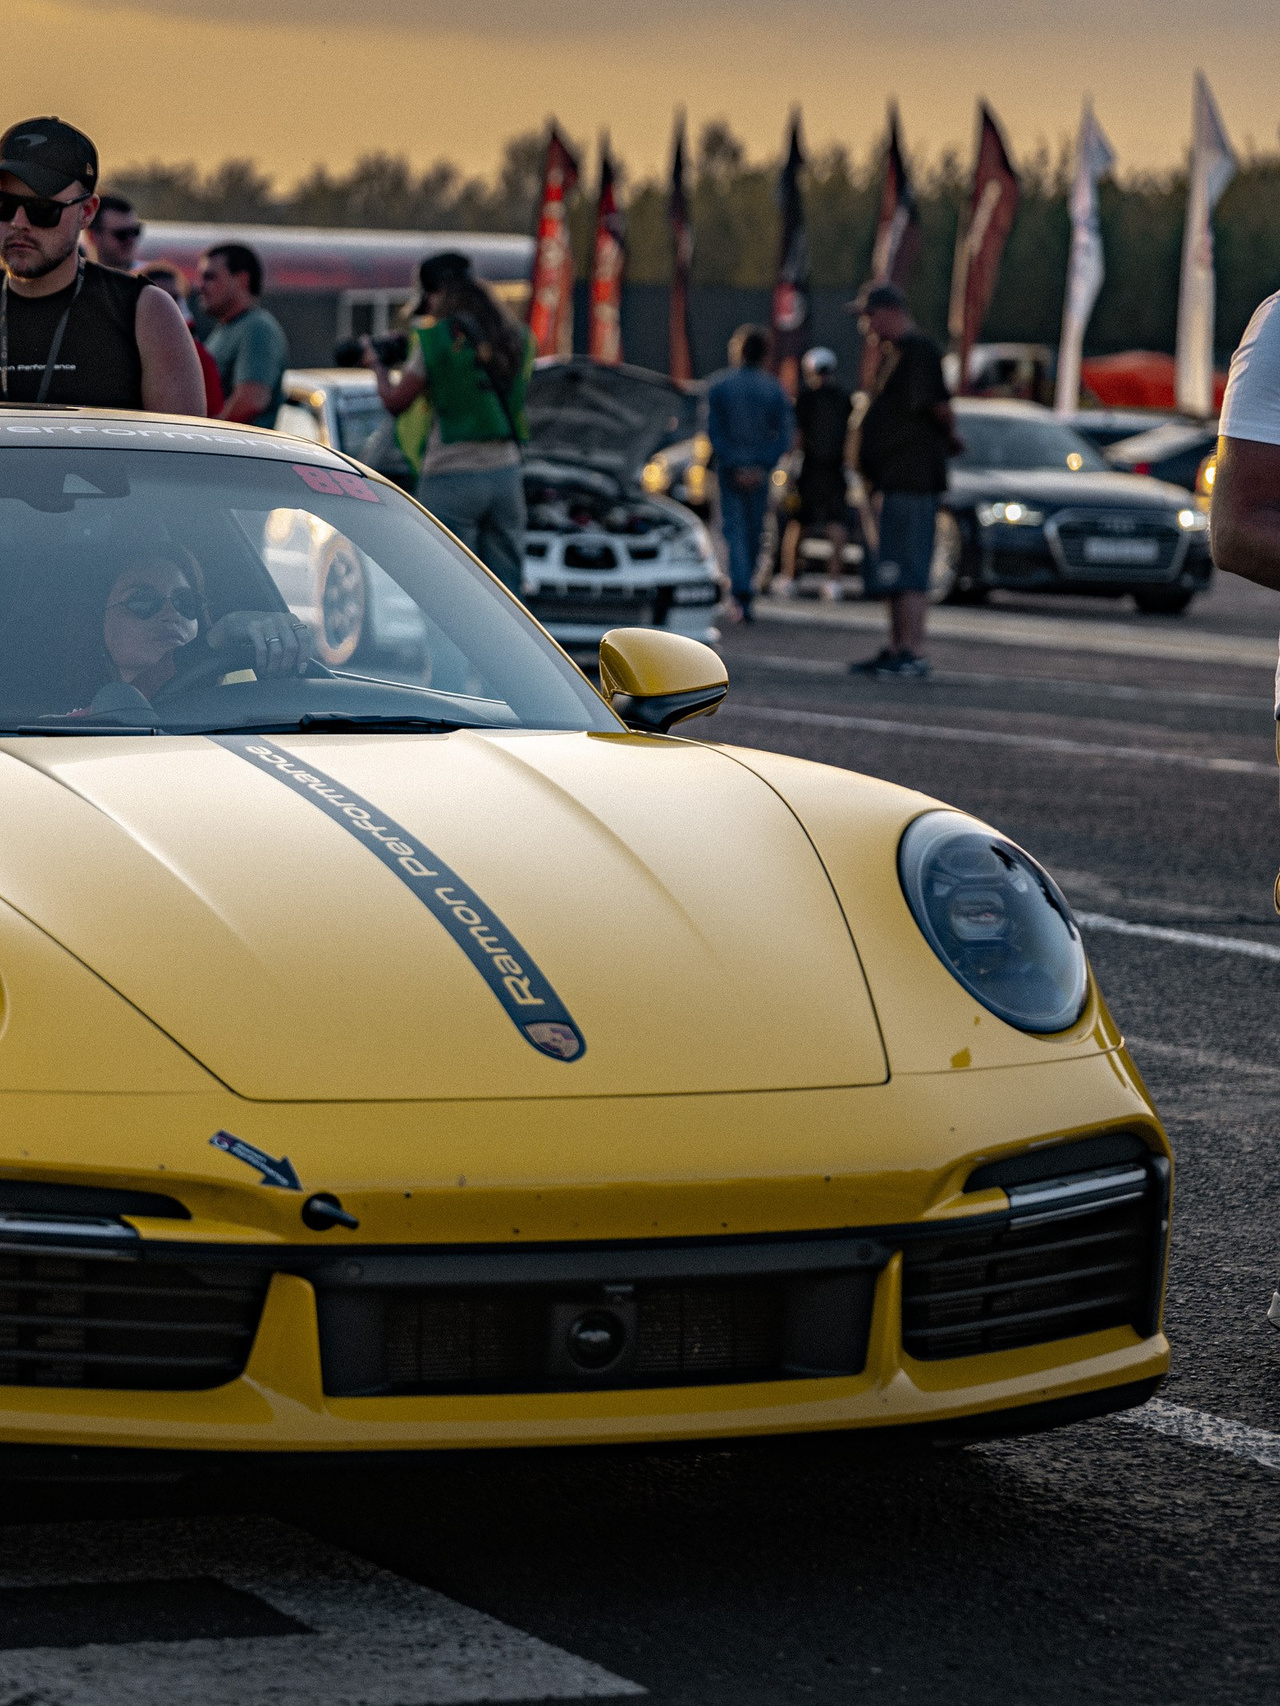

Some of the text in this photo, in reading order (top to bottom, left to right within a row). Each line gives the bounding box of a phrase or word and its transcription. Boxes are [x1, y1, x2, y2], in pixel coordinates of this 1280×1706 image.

[17, 363, 77, 371] Perforance
[291, 464, 381, 504] 88
[245, 743, 546, 1006] Ramon Performance
